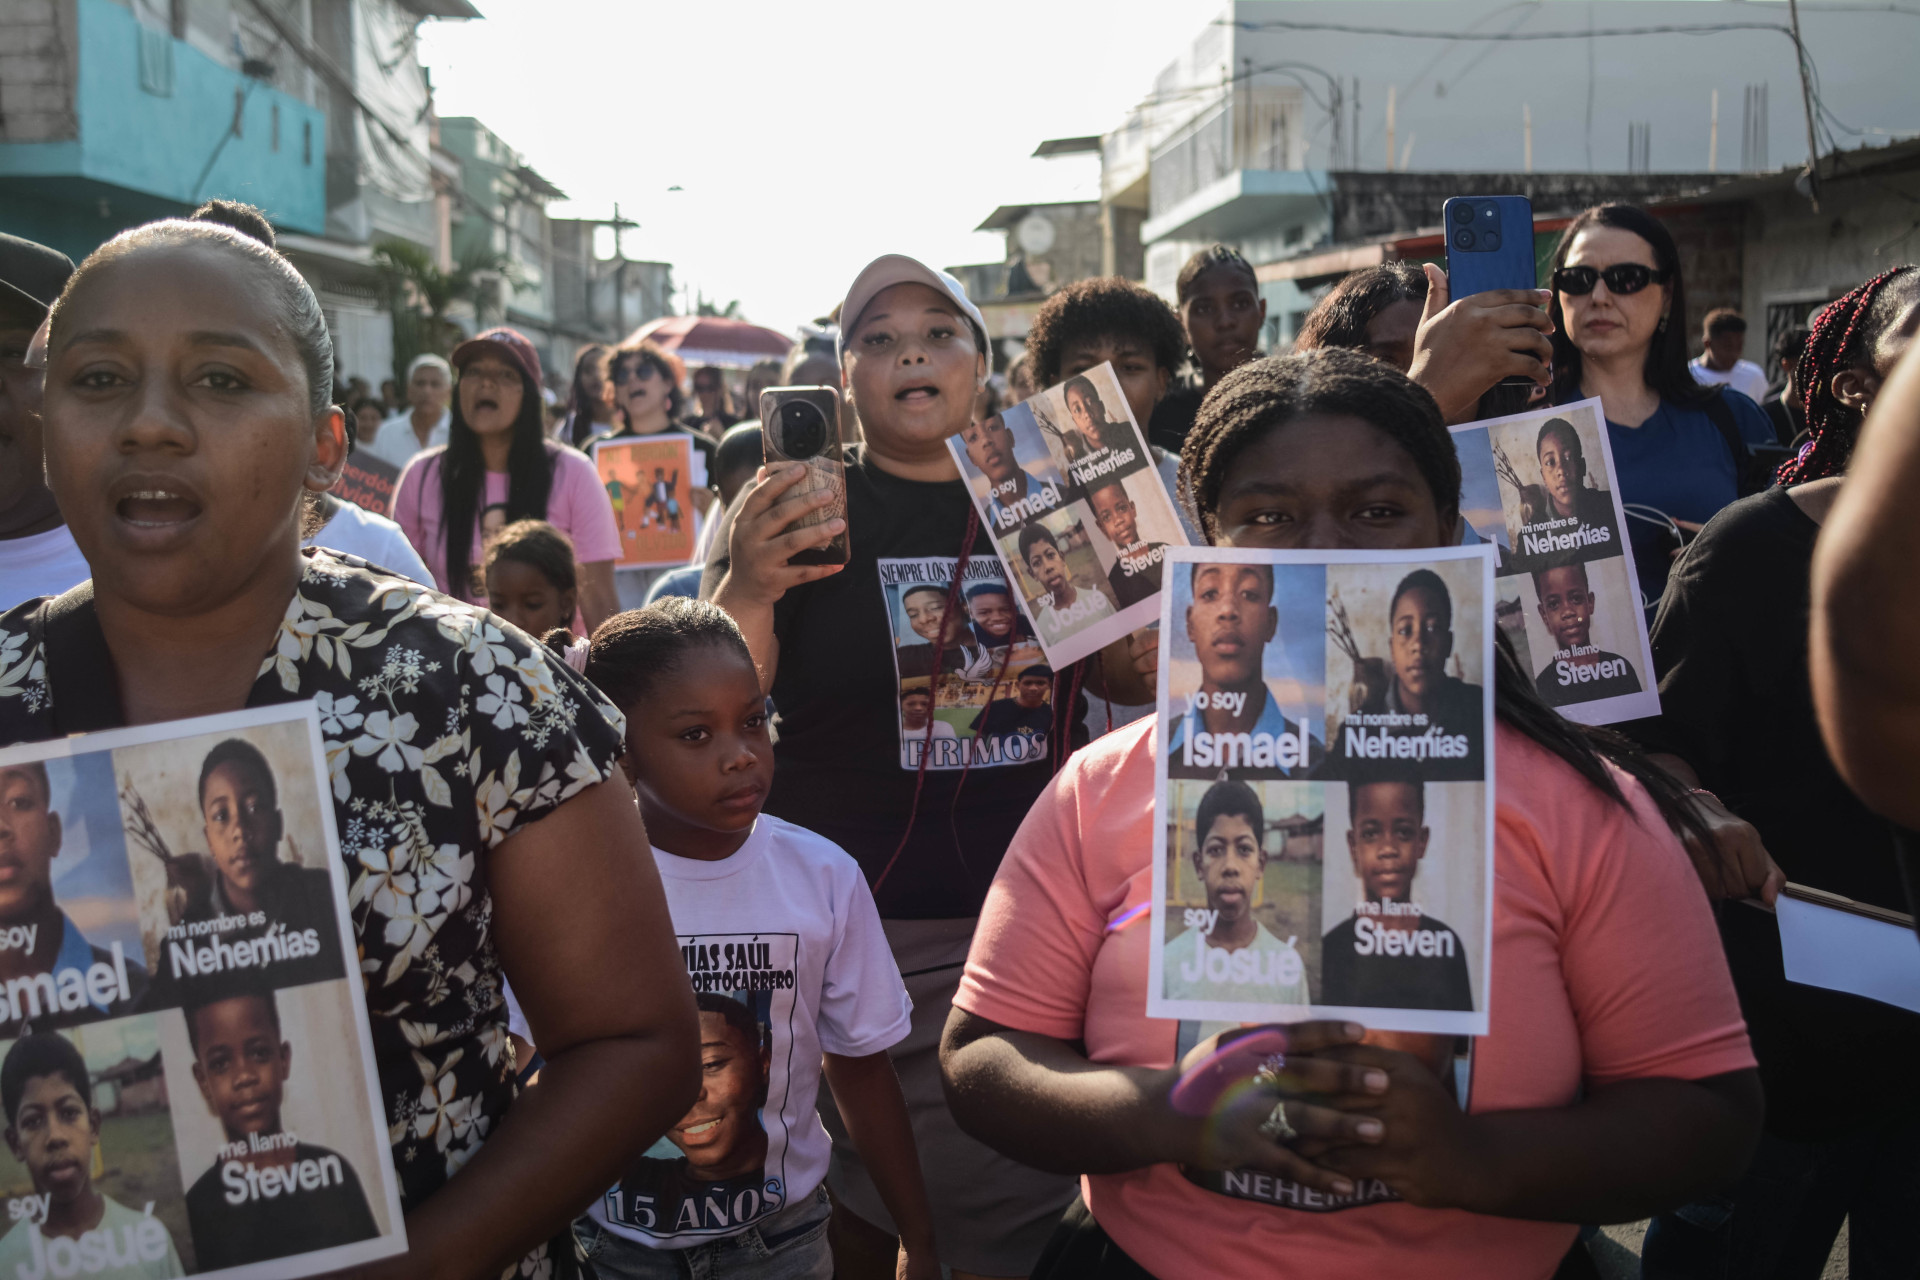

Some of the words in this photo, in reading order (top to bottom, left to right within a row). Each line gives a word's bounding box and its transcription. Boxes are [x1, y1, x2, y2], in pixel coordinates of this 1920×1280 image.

[1069, 460, 1077, 471] mi
[1077, 450, 1101, 466] nombre
[1071, 448, 1135, 486] Nehemías
[999, 478, 1017, 494] soy
[992, 477, 1062, 530] Ismael
[1521, 522, 1533, 534] mi
[1533, 518, 1567, 533] nombre
[1568, 516, 1578, 525] es
[1523, 523, 1611, 556] Nehemías
[880, 562, 926, 584] SIEMPRE
[926, 562, 947, 582] LOS
[1036, 591, 1055, 607] soy
[1048, 584, 1107, 633] Josué
[1554, 649, 1571, 660] me
[1571, 644, 1600, 657] llamo
[1556, 658, 1627, 686] Steven
[1184, 692, 1209, 716] yo
[1211, 691, 1247, 716] soy
[1345, 710, 1362, 725] mi
[1363, 710, 1411, 726] nombre
[1413, 714, 1428, 726] es
[908, 733, 1047, 767] PRIMOS
[1183, 718, 1309, 768] Ismael
[1345, 727, 1468, 760] Nehemías
[1184, 908, 1219, 936] soy
[1355, 901, 1380, 916] me
[1382, 897, 1423, 916] llamo
[168, 920, 187, 939] mi
[188, 912, 247, 937] nombre
[248, 910, 267, 926] es
[1354, 917, 1454, 957] Steven
[168, 923, 321, 979] Nehemías
[724, 935, 773, 970] SAÚL
[1181, 931, 1301, 985] Josué
[692, 970, 795, 992] ORTOCARRERO
[219, 1140, 248, 1159] me
[249, 1131, 299, 1153] llamo
[222, 1154, 344, 1206] Steven
[8, 1192, 51, 1226] soy
[609, 1189, 656, 1228] 15
[675, 1179, 783, 1231] AÑOS
[16, 1201, 168, 1280] Josué
